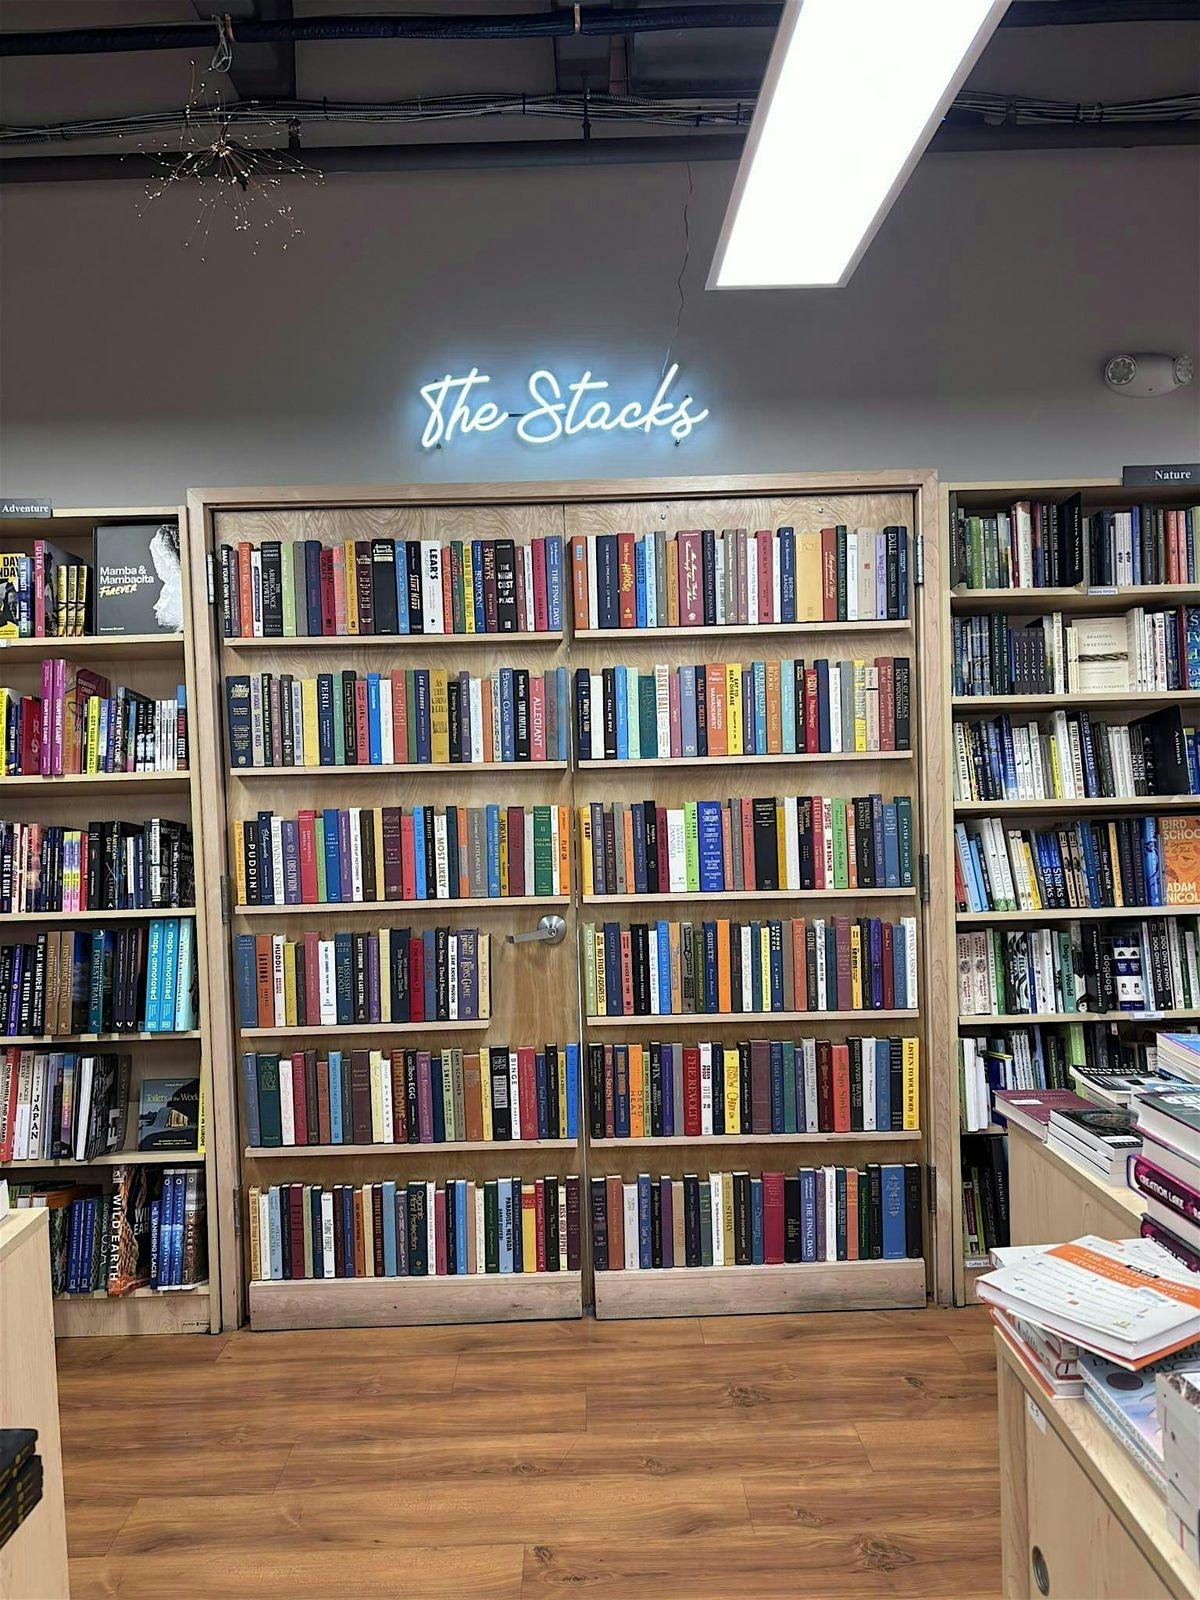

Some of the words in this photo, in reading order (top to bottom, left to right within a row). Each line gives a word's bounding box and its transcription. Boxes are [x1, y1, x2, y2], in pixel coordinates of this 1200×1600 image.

[420, 367, 508, 447] The
[517, 363, 709, 443] Stacks
[1155, 470, 1191, 480] Nature
[2, 504, 49, 512] Adventure
[100, 567, 137, 576] Mamba
[139, 566, 146, 574] &
[430, 549, 438, 580] LEAR'S
[622, 564, 634, 592] Heloise
[100, 575, 154, 585] Mambacita
[322, 680, 330, 710] PERIL
[657, 668, 668, 714] BASKETBALL
[534, 696, 542, 748] ALLEGIANT
[178, 738, 186, 758] EFFECT
[1086, 736, 1094, 770] WARRIORS
[1174, 731, 1182, 765] Animals
[1162, 820, 1186, 829] BIRD
[438, 838, 446, 860] MOST
[960, 834, 970, 862] WHALE
[2, 854, 11, 872] ONCE
[248, 844, 256, 893] PUDDIN'
[288, 860, 298, 892] OBLIVION
[438, 863, 446, 888] LIKELY
[2, 880, 10, 897] GIANT
[1043, 868, 1054, 898] Sharks
[1053, 868, 1064, 898] Sharks
[1167, 882, 1196, 892] ADAM
[166, 932, 174, 956] maps,
[598, 948, 602, 958] NO
[1062, 944, 1070, 962] Dogs
[24, 972, 31, 980] WE
[165, 957, 173, 1000] annotated
[258, 954, 268, 983] LATINOS
[1103, 955, 1113, 995] dogdogs
[1065, 974, 1073, 996] World
[688, 1056, 697, 1078] THE
[838, 1072, 847, 1088] Spy
[908, 1067, 914, 1075] TO
[394, 1057, 405, 1120] TURTLEDOVE
[689, 1080, 698, 1118] REVOLT
[31, 1094, 40, 1140] JAPAN
[840, 1090, 848, 1120] Sinker
[1140, 1174, 1168, 1200] CREATION
[1168, 1192, 1184, 1210] LAKE
[112, 1194, 121, 1228] WILD
[110, 1236, 120, 1280] EARTH
